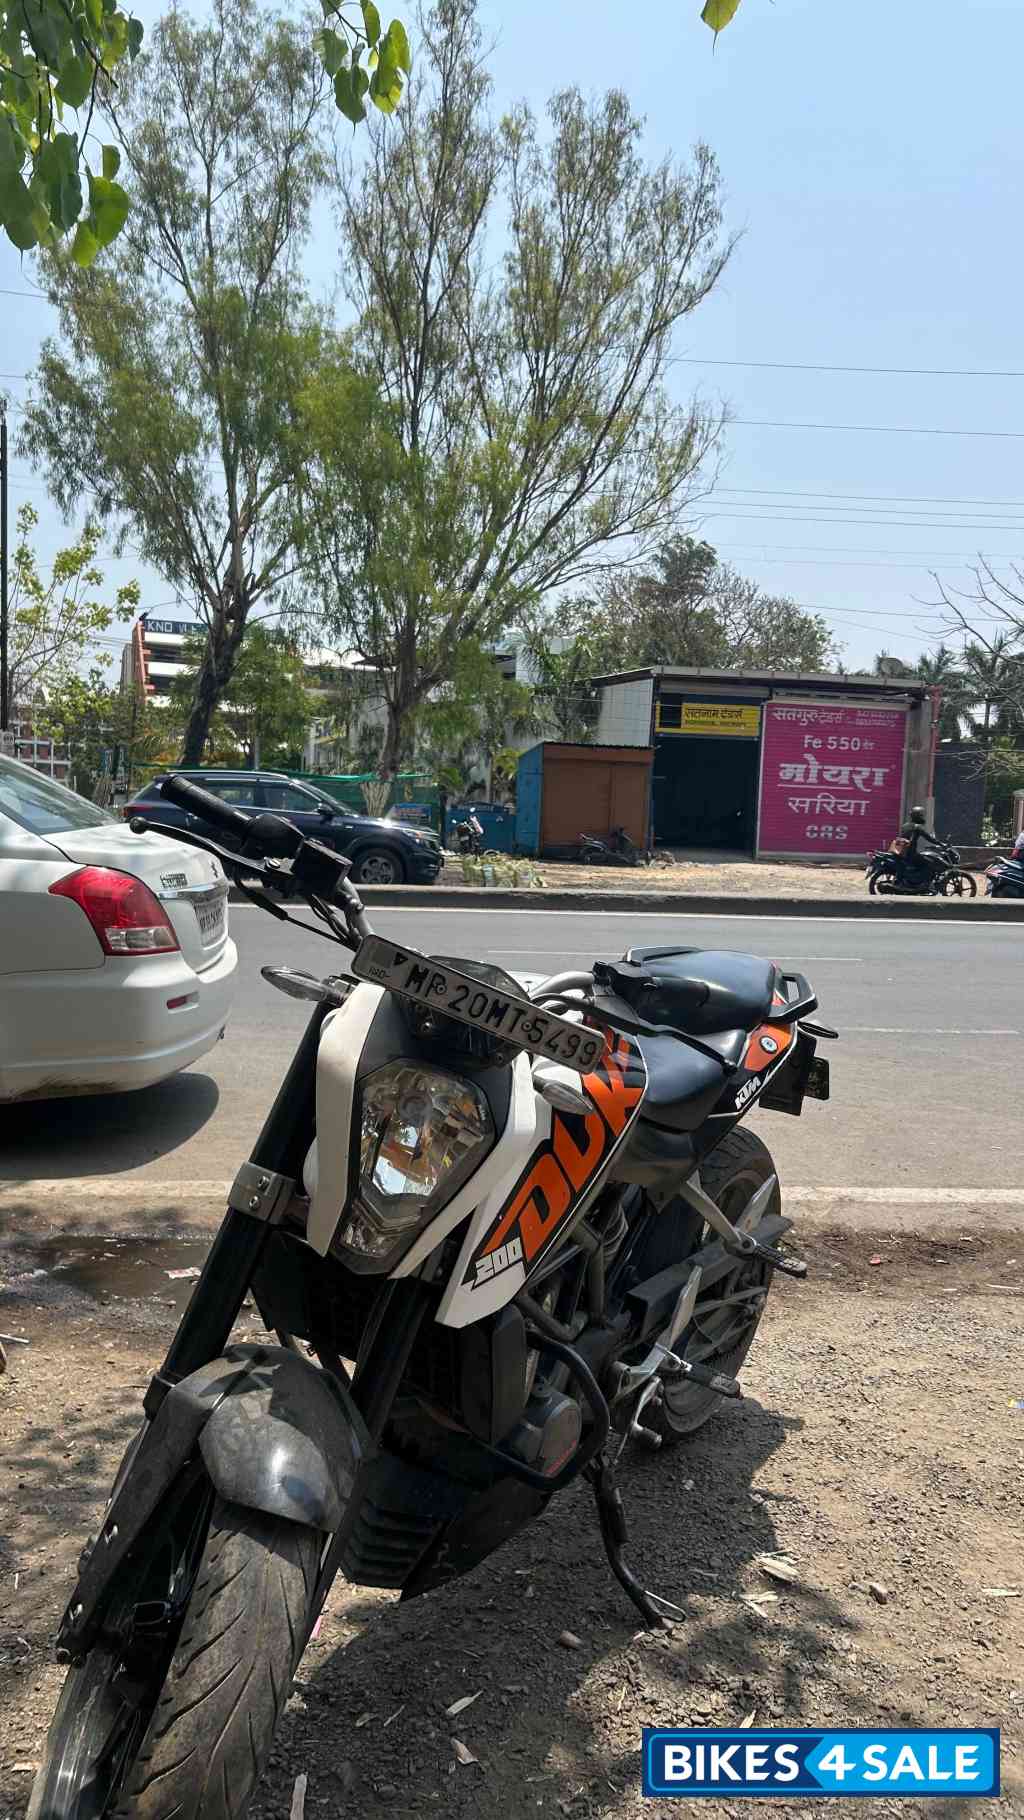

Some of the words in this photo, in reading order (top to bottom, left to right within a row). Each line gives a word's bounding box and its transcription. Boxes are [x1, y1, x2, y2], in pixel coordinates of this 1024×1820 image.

[803, 735, 822, 748] Fe
[827, 736, 861, 751] 550
[779, 754, 889, 793] मोयरा
[788, 792, 870, 816] सरिया
[405, 963, 446, 1000] MP
[527, 1017, 598, 1066] 5499
[734, 1075, 762, 1110] KTM
[474, 1238, 523, 1284] 200
